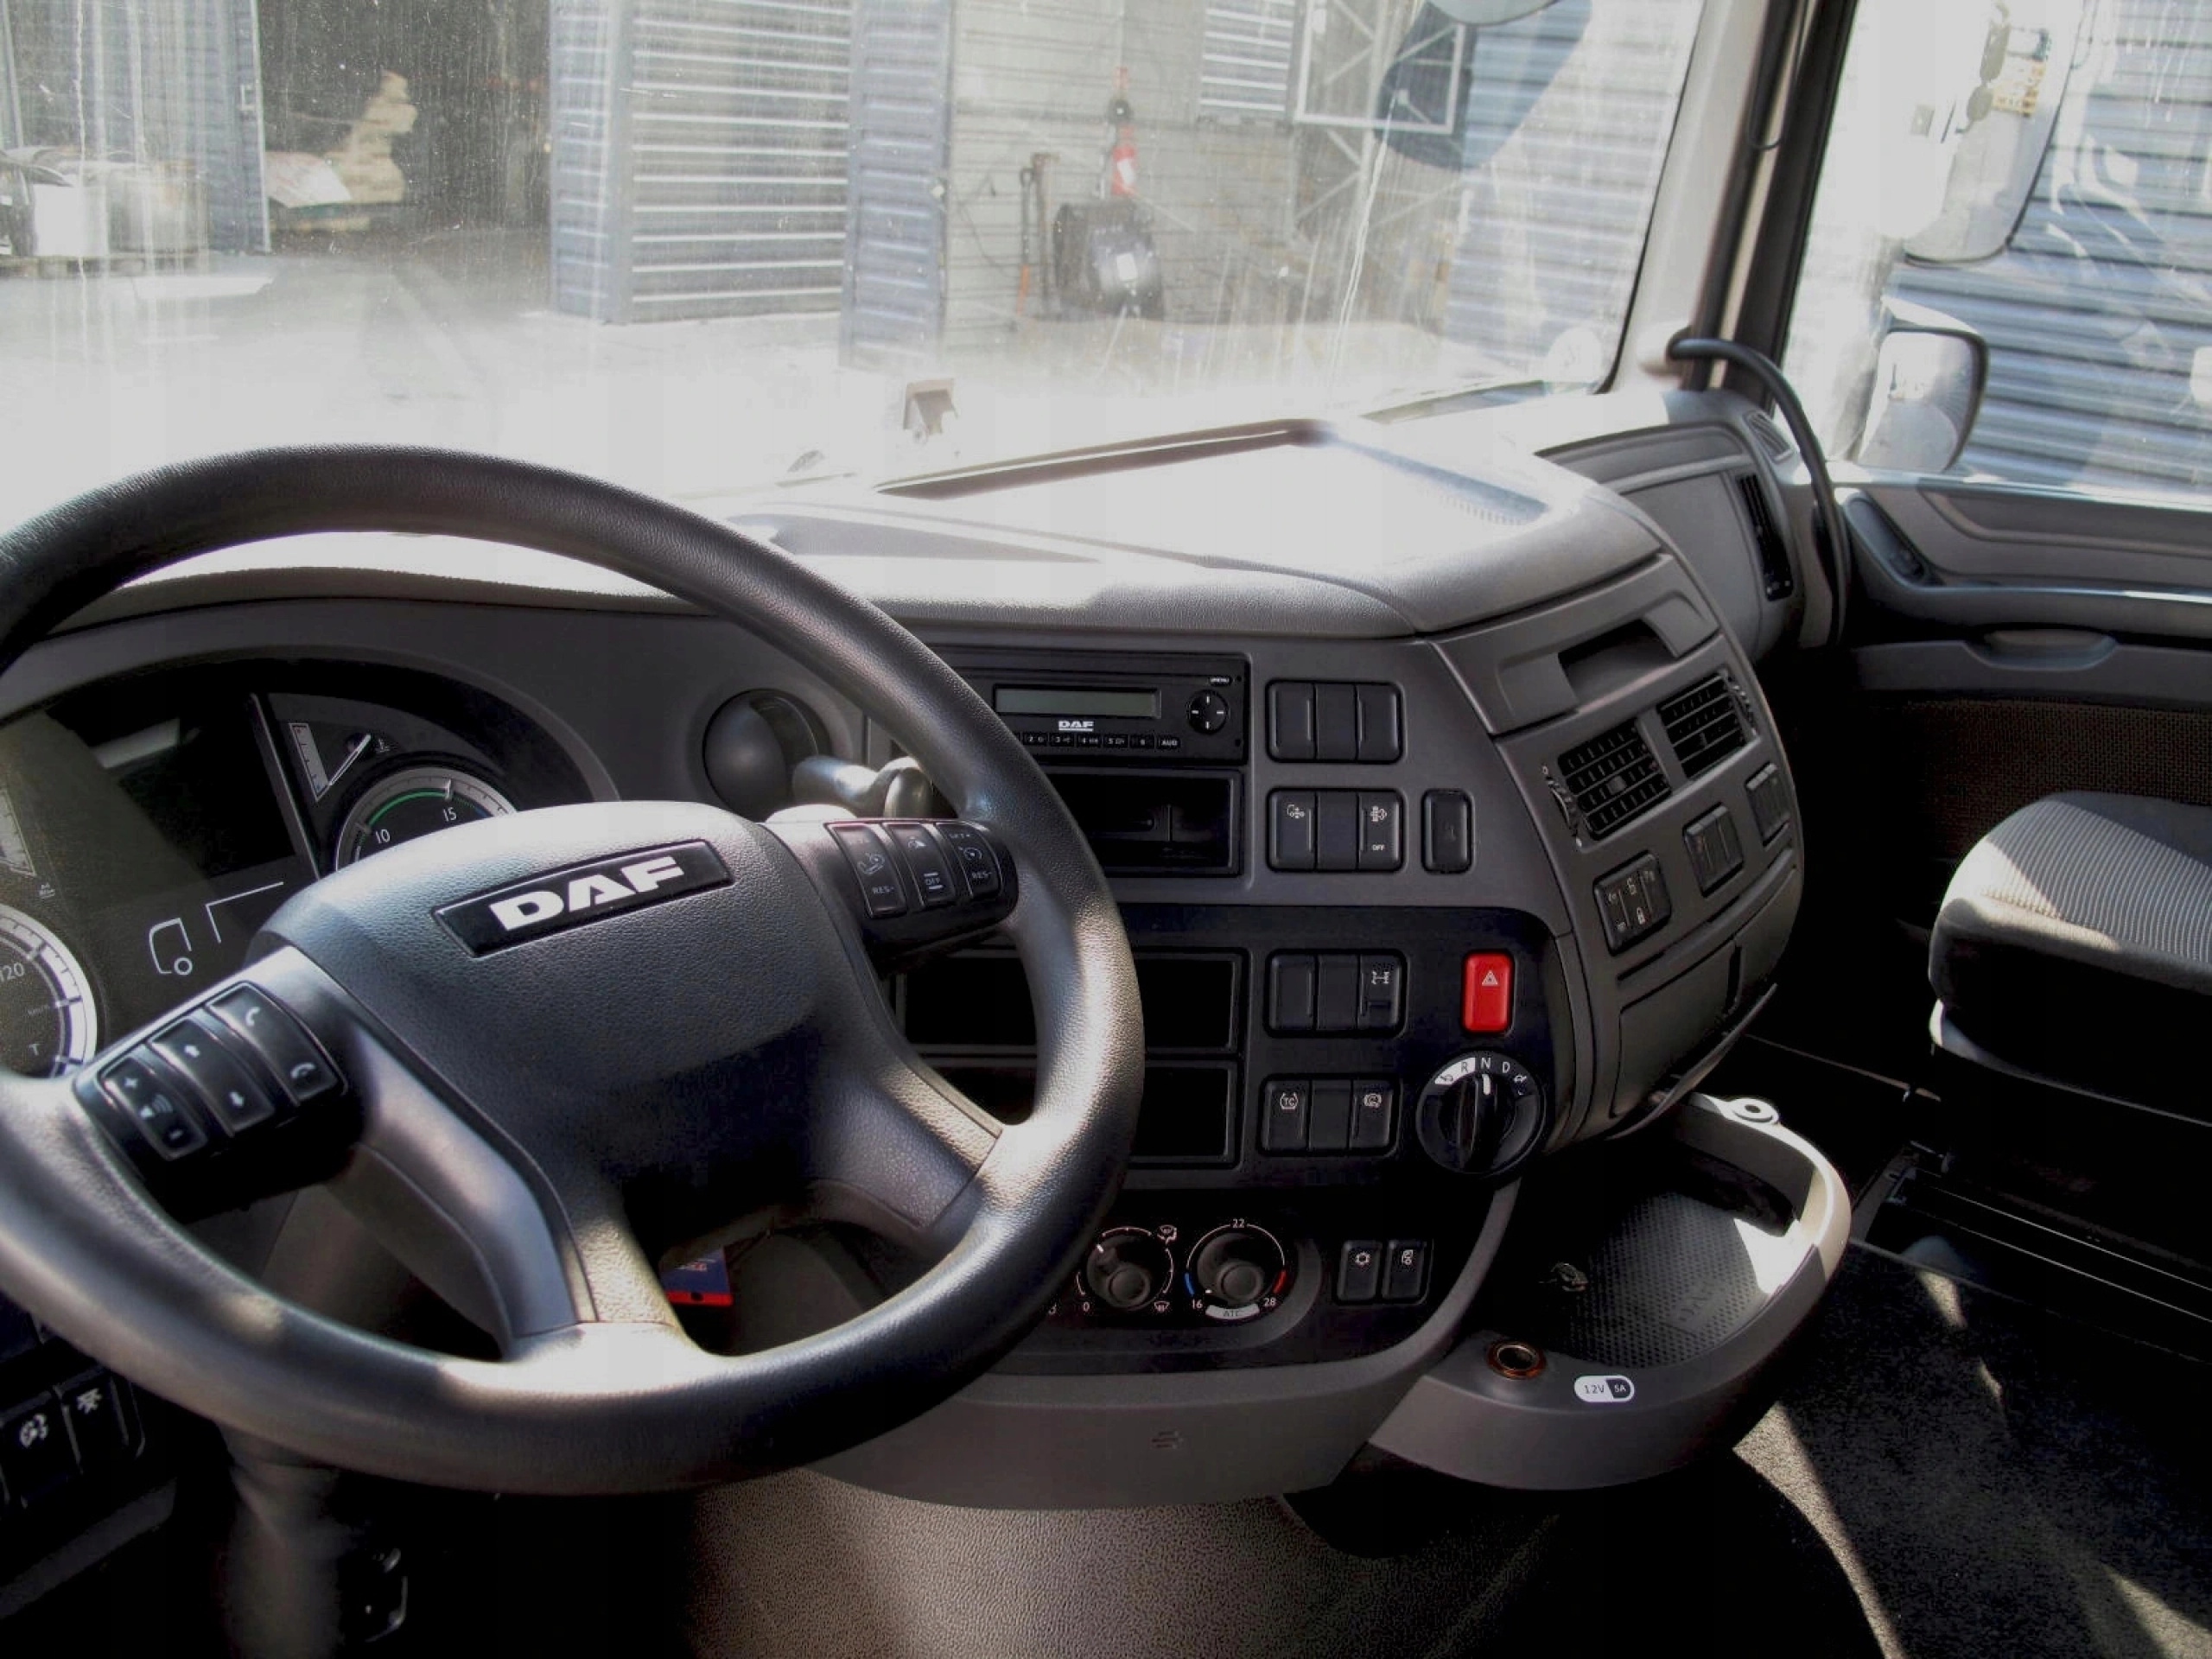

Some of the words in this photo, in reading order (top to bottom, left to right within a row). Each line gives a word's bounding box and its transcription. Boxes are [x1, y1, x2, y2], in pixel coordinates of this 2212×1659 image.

[1058, 720, 1094, 728] DAF
[442, 807, 457, 822] 15
[375, 829, 391, 844] 10
[489, 855, 685, 931] DAF
[0, 962, 24, 982] 120
[1461, 1062, 1469, 1073] R
[1480, 1057, 1491, 1070] N
[1502, 1061, 1510, 1073] D
[1232, 1217, 1245, 1229] 22
[1083, 1301, 1090, 1313] 0
[1192, 1299, 1203, 1309] 16
[1263, 1297, 1276, 1307] 28
[1584, 1384, 1605, 1394] 12V
[1614, 1383, 1626, 1393] 5A
